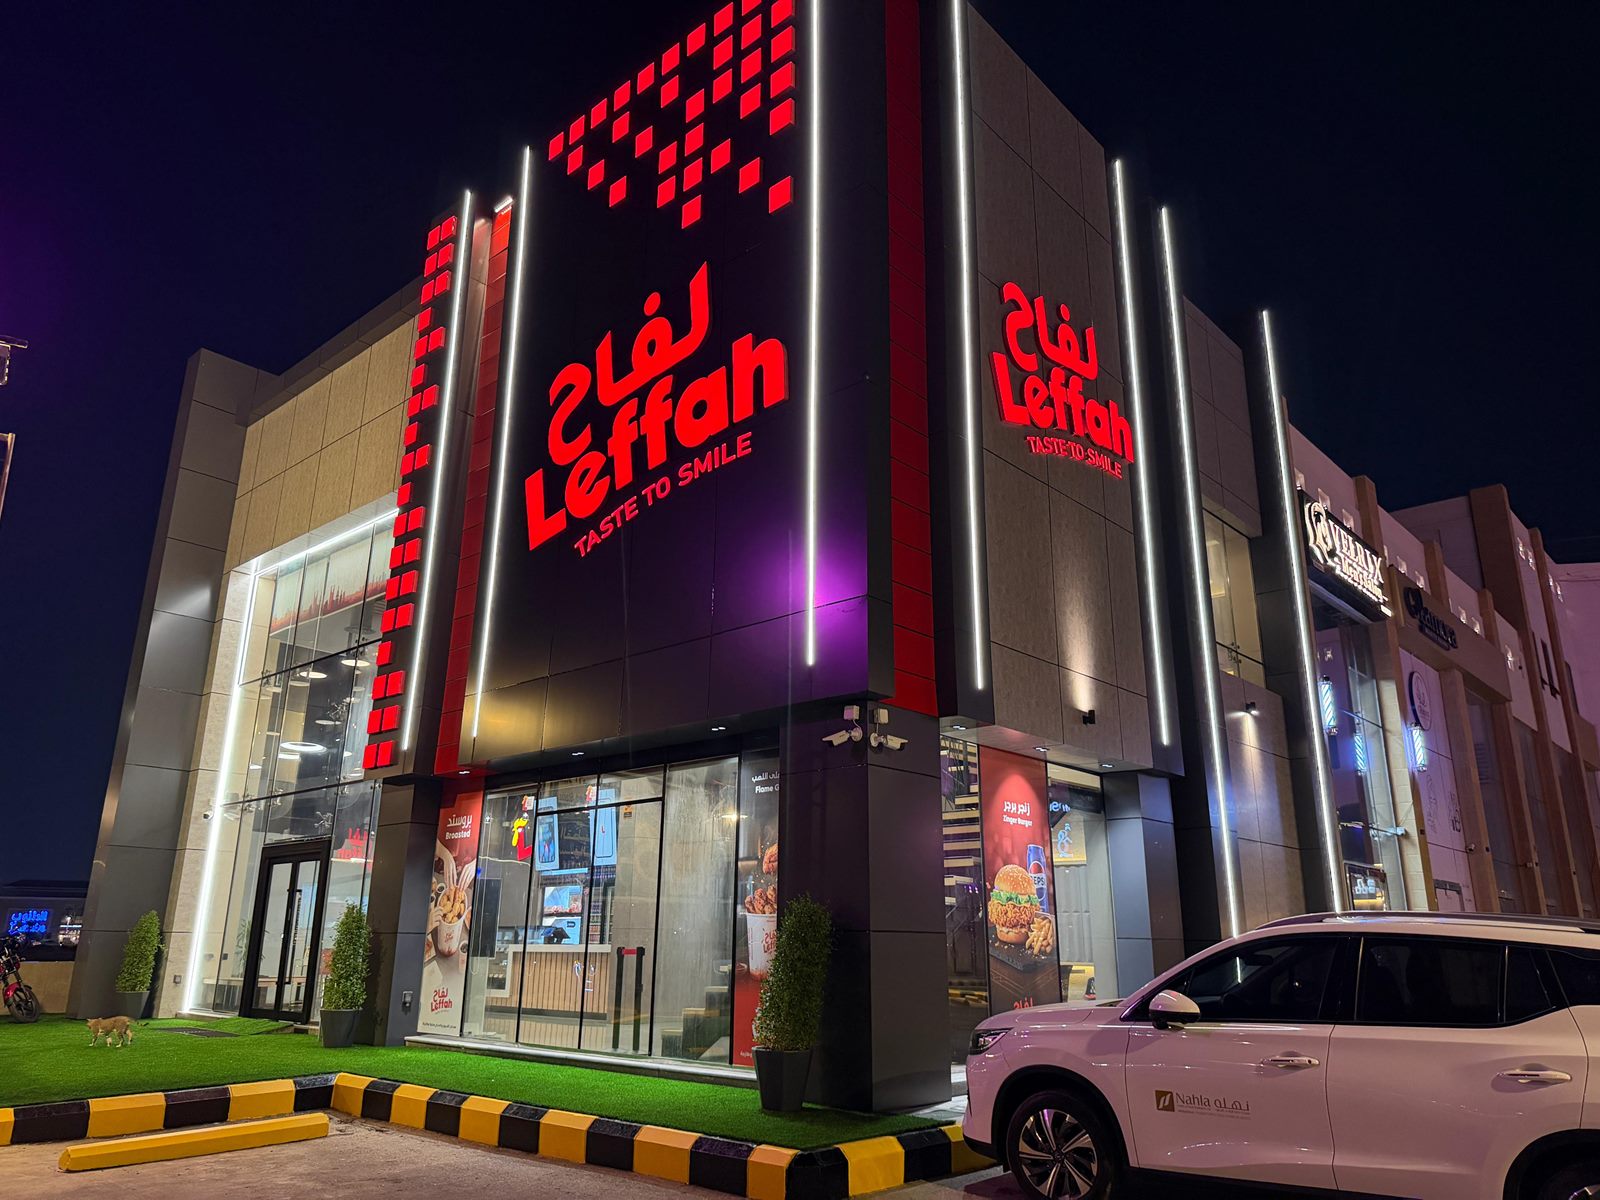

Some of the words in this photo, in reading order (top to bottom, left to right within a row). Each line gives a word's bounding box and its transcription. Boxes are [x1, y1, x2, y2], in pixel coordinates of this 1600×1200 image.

[1002, 281, 1099, 380] لفاح
[549, 261, 710, 466] لفاح
[990, 351, 1134, 463] Leffah
[525, 333, 787, 551] Leffah
[1026, 436, 1068, 457] TASTE
[1067, 440, 1085, 461] TO
[1086, 447, 1123, 480] SMILE
[574, 496, 639, 558] TASTE
[641, 476, 671, 507] TO
[678, 431, 752, 487] SMILE
[755, 785, 774, 794] Flame
[445, 829, 472, 840] Broasted
[430, 998, 453, 1012] Leffah
[432, 987, 449, 1003] لفاح
[1176, 1092, 1211, 1108] Nahla
